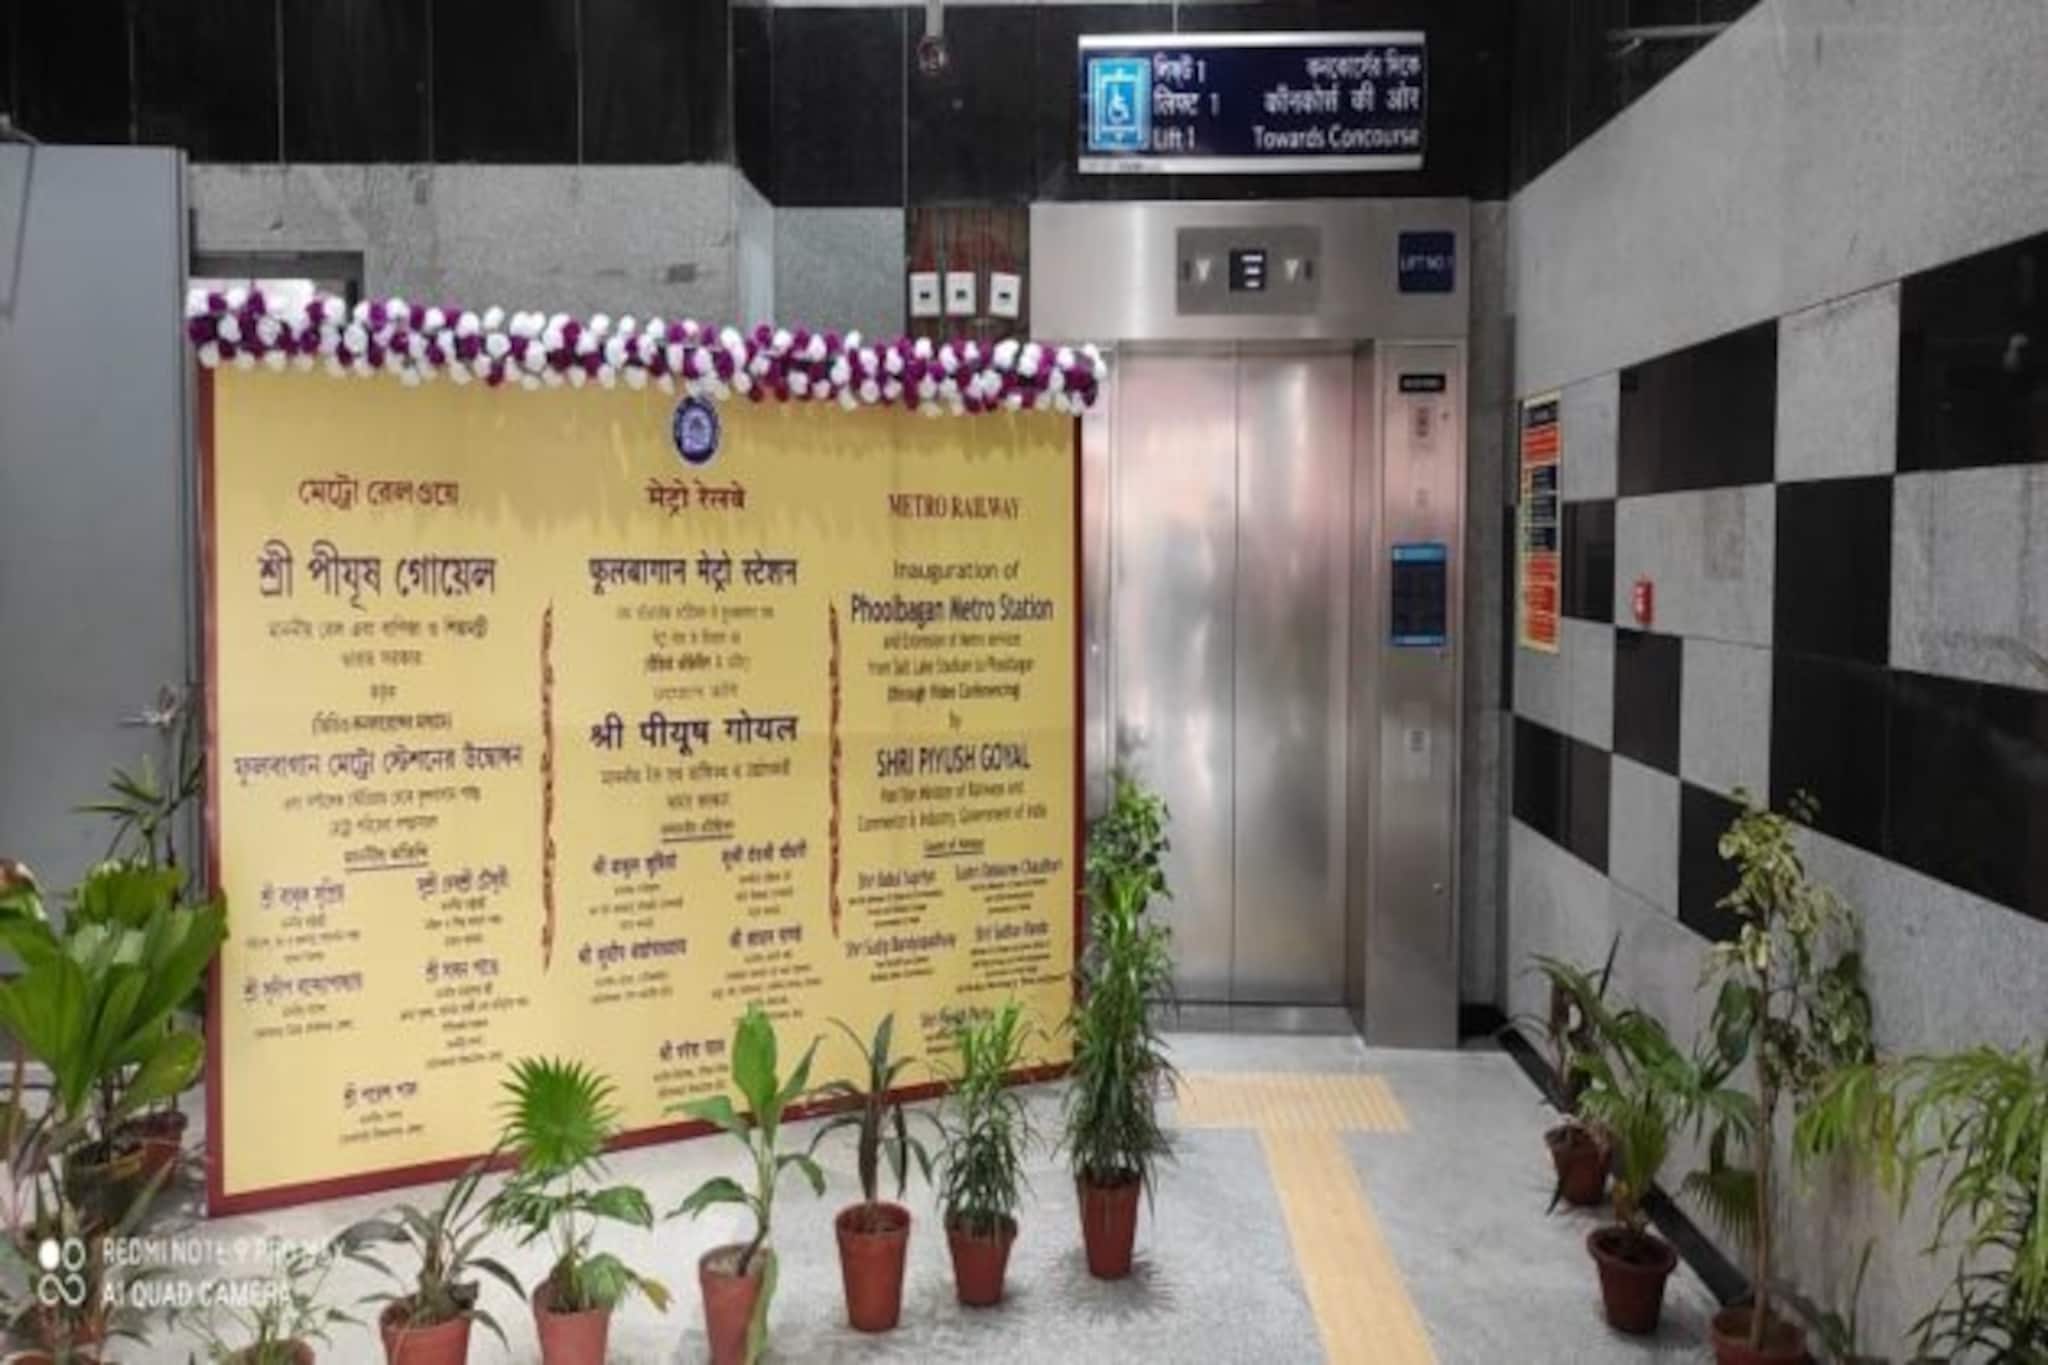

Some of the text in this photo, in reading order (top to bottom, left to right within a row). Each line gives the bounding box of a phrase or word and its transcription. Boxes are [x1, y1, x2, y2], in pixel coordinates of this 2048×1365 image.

[1153, 125, 1196, 150] Lift 1
[1253, 123, 1420, 150] Towards Concourse
[299, 473, 358, 510] মেট্রো
[646, 478, 745, 517] मेट्रो रेलवे
[888, 494, 1020, 520] METRO RAILWAY
[258, 539, 293, 597] শ্রী
[396, 554, 497, 597] গোয়েল
[588, 549, 798, 595] फूलबागान मेट्रो स्टेशन
[893, 560, 1020, 584] Inauguration of
[851, 593, 1054, 629] Phoolbagan Metro Station
[590, 709, 799, 756] श्री पीयूष गोयल
[876, 742, 1032, 777] SHRI PIYUSH GOYAL
